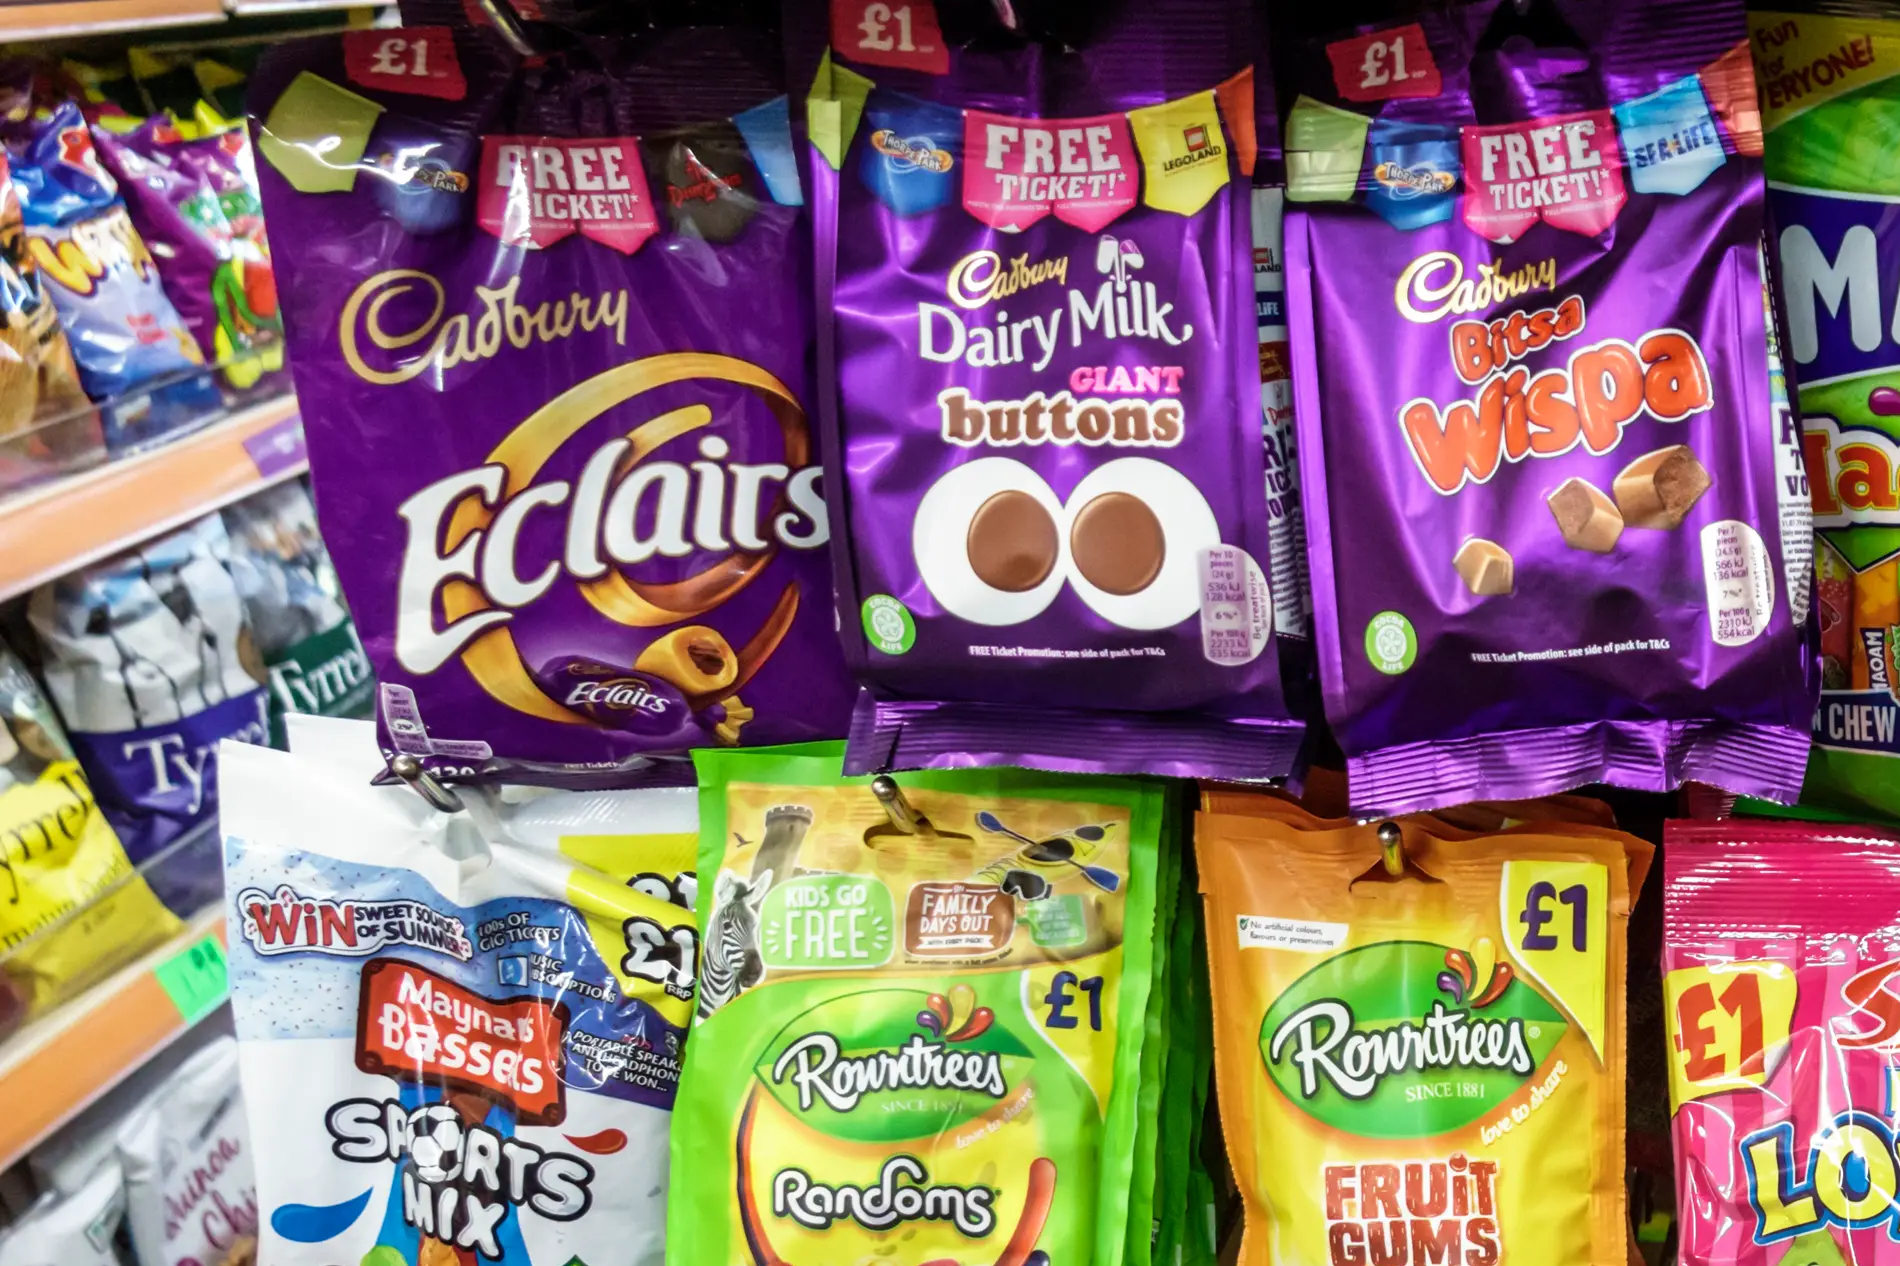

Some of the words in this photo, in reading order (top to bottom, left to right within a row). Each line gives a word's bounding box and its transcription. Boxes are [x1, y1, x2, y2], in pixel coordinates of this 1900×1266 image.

[858, 2, 916, 52] £1
[1360, 37, 1411, 89] £1
[495, 145, 631, 191] FREE
[984, 123, 1120, 173] FREE
[1163, 144, 1222, 173] LEGOLAND
[1480, 119, 1602, 182] FREE
[947, 249, 1069, 309] Cadbury
[1394, 251, 1558, 323] Cadbury
[339, 269, 628, 384] Cadbury
[918, 301, 1063, 372] Dairy
[1069, 276, 1193, 346] Milk
[1451, 295, 1586, 384] Bitsa
[1069, 365, 1184, 394] GIANT
[937, 387, 1185, 446] buttons
[1400, 328, 1714, 495] Wispa
[395, 436, 830, 674] Eclairs
[1471, 653, 1492, 662] FREE
[1493, 652, 1517, 662] Ticket
[1518, 649, 1567, 661] Promotion:
[1568, 648, 1583, 657] see
[1584, 645, 1602, 656] side
[1604, 642, 1614, 653] of
[1615, 640, 1635, 654] pack
[1636, 639, 1648, 649] for
[1649, 638, 1670, 649] T&Cs
[565, 681, 671, 713] Eclairs
[1829, 703, 1896, 744] CHEW
[250, 902, 356, 948] WiN
[785, 886, 831, 909] KIDS
[836, 885, 867, 905] GO
[920, 916, 957, 934] DAYS
[960, 915, 994, 932] OUT
[922, 894, 996, 917] FAMILY
[1519, 880, 1589, 952] £1
[784, 910, 869, 961] FREE
[1045, 970, 1105, 1032] £1
[1674, 973, 1768, 1080] £1
[772, 1031, 1008, 1113] Rowntrees
[1270, 998, 1536, 1102] Rowntrees
[1405, 1082, 1453, 1102] SINCE
[1456, 1082, 1485, 1098] 1881
[402, 1169, 508, 1261] MIX
[772, 1153, 996, 1239] Randoms
